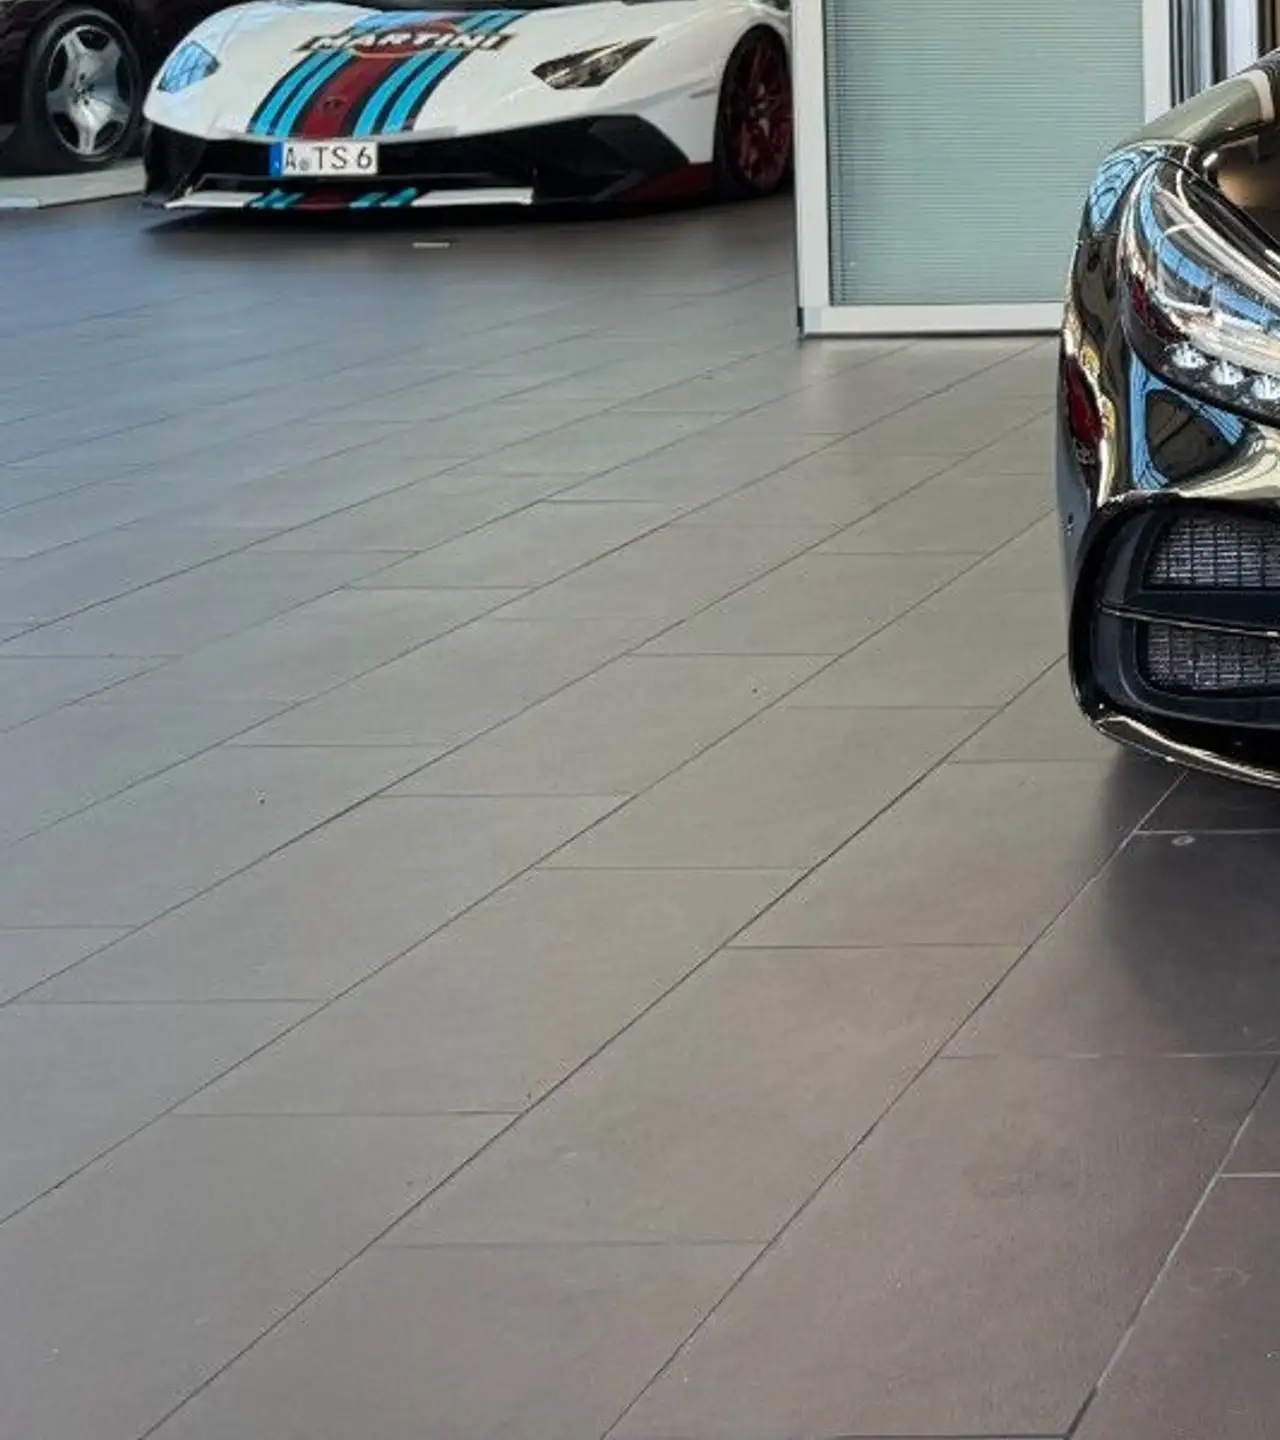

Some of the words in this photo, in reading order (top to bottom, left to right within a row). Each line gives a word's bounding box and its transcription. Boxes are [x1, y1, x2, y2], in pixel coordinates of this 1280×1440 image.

[307, 32, 503, 50] MARTINI
[285, 147, 297, 170] A
[312, 146, 348, 170] TS
[357, 146, 373, 169] 6
